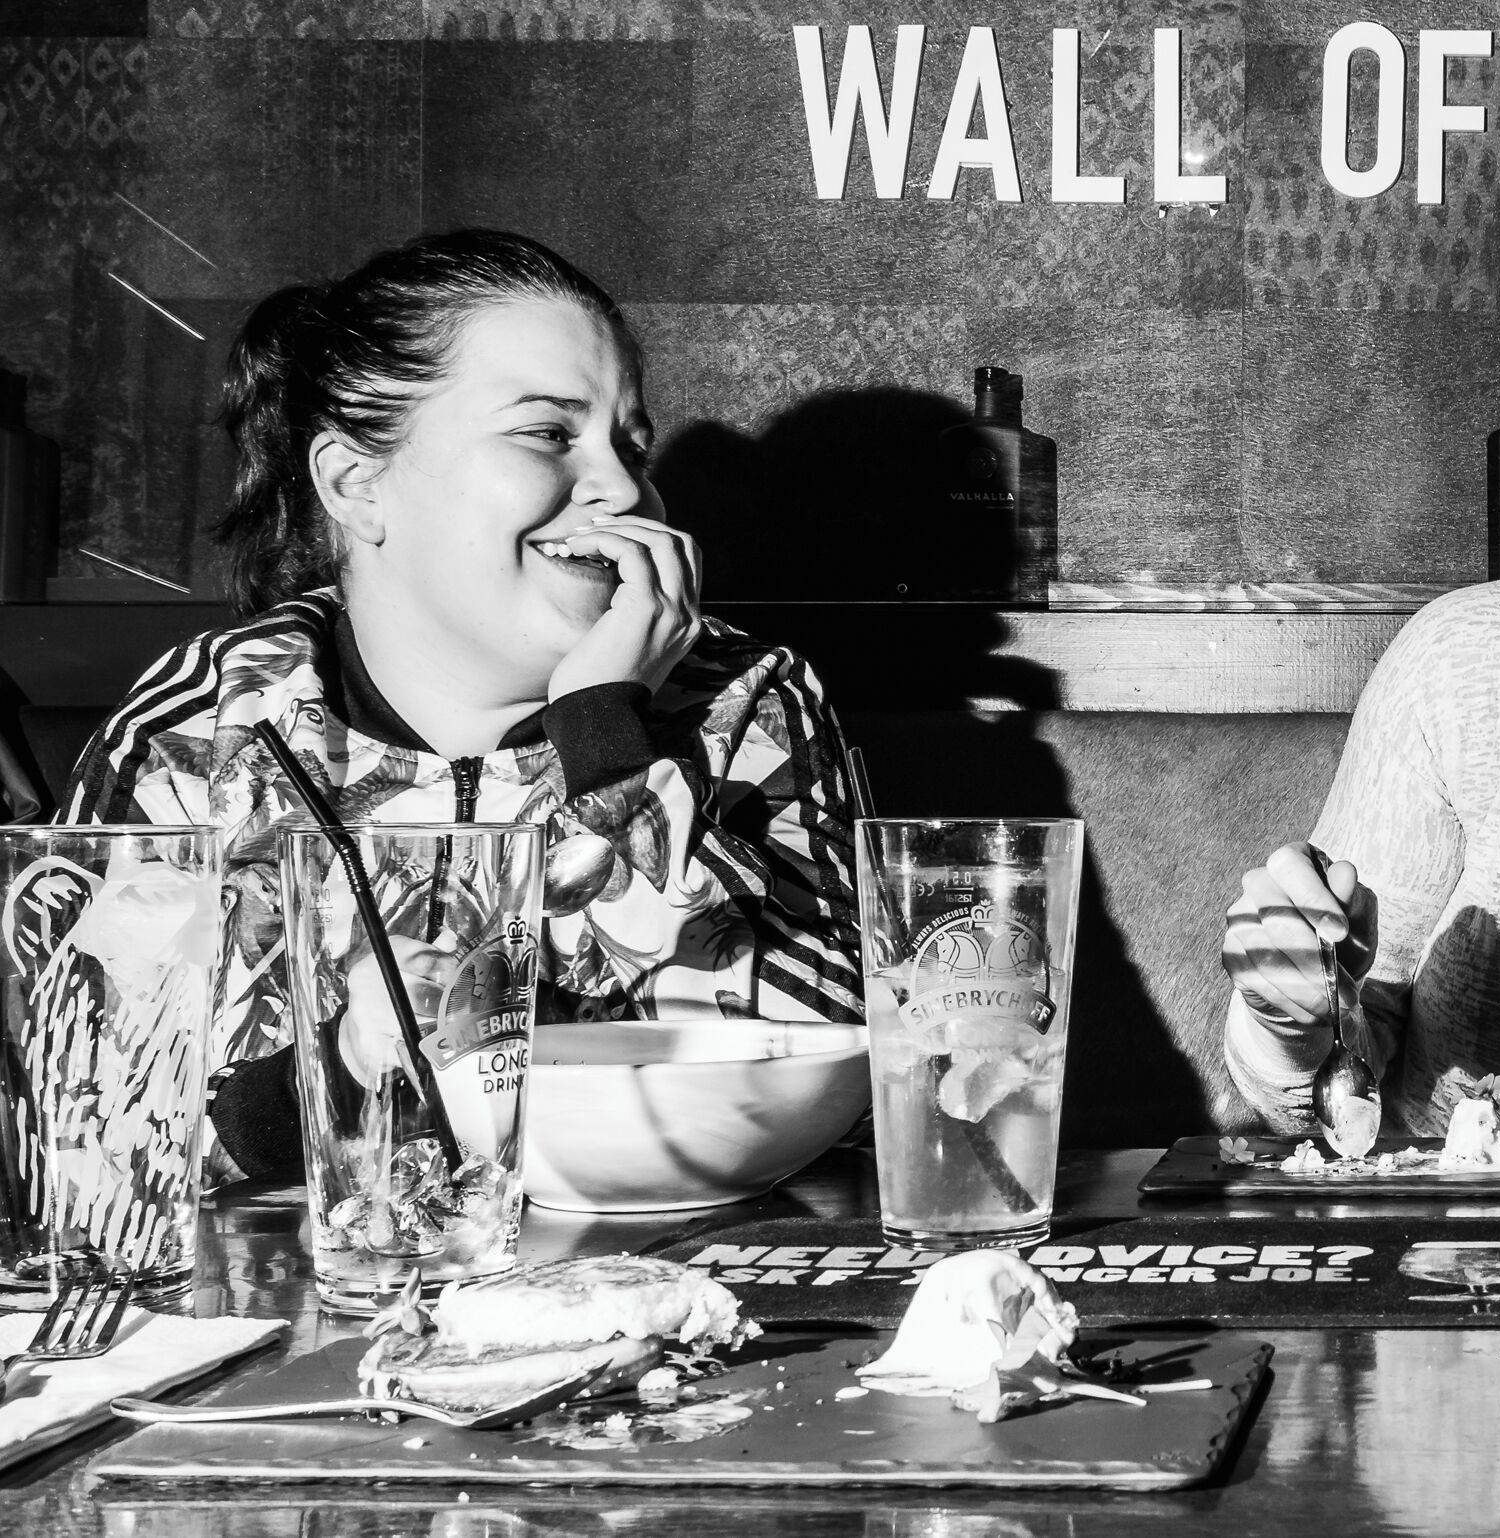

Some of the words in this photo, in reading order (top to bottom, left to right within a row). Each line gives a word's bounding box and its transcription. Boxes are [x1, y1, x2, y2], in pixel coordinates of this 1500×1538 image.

[792, 24, 1227, 204] WALL
[1322, 21, 1495, 206] OF
[950, 492, 1015, 501] VALHALLA
[911, 925, 933, 950] ALWAYS
[931, 906, 970, 928] DELICIOUS
[478, 1049, 528, 1074] LONG
[687, 1243, 949, 1269] NEED
[1018, 1244, 1375, 1267] DVICE?
[1040, 1267, 1218, 1283] NGER
[1229, 1266, 1371, 1282] JOE.
